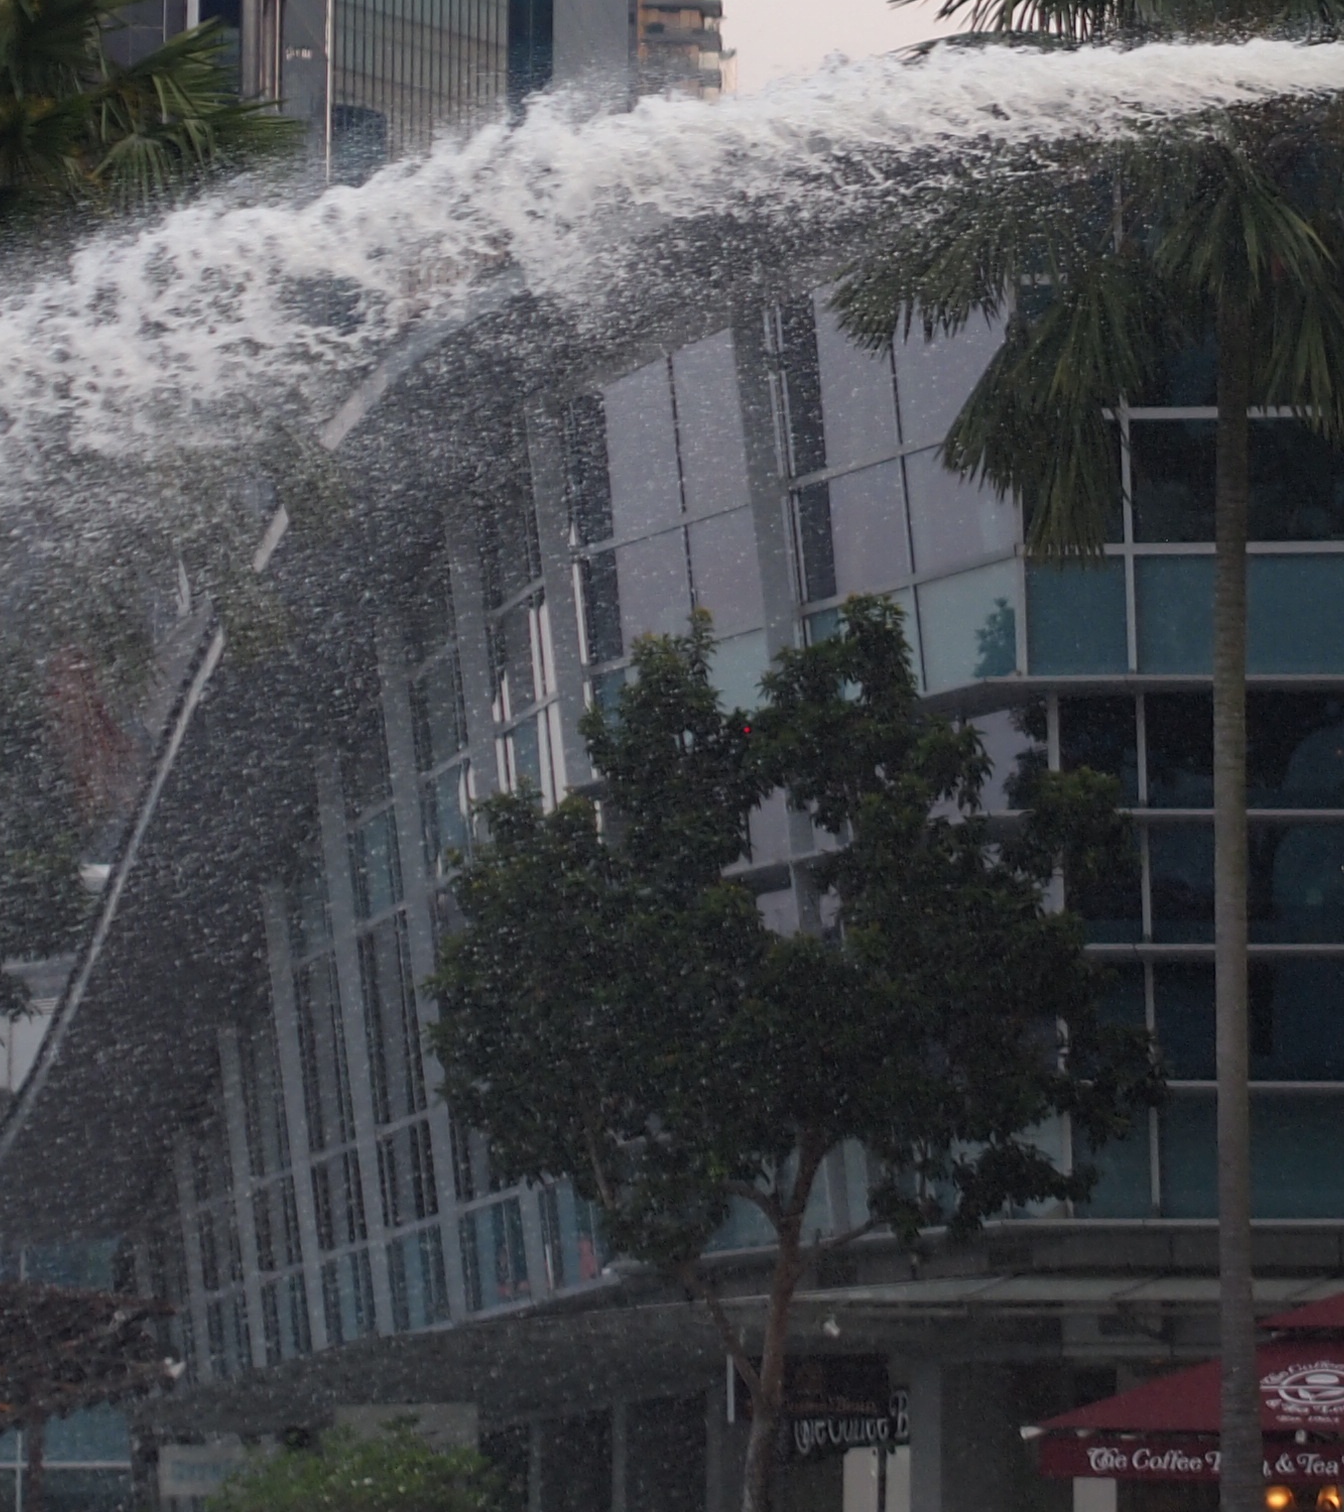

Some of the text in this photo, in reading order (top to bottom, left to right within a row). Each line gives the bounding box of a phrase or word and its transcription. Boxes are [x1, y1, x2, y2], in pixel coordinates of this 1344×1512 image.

[1087, 1447, 1127, 1472] The
[1131, 1448, 1203, 1473] Coffee
[1275, 1452, 1295, 1474] &
[1296, 1453, 1339, 1475] Tea
